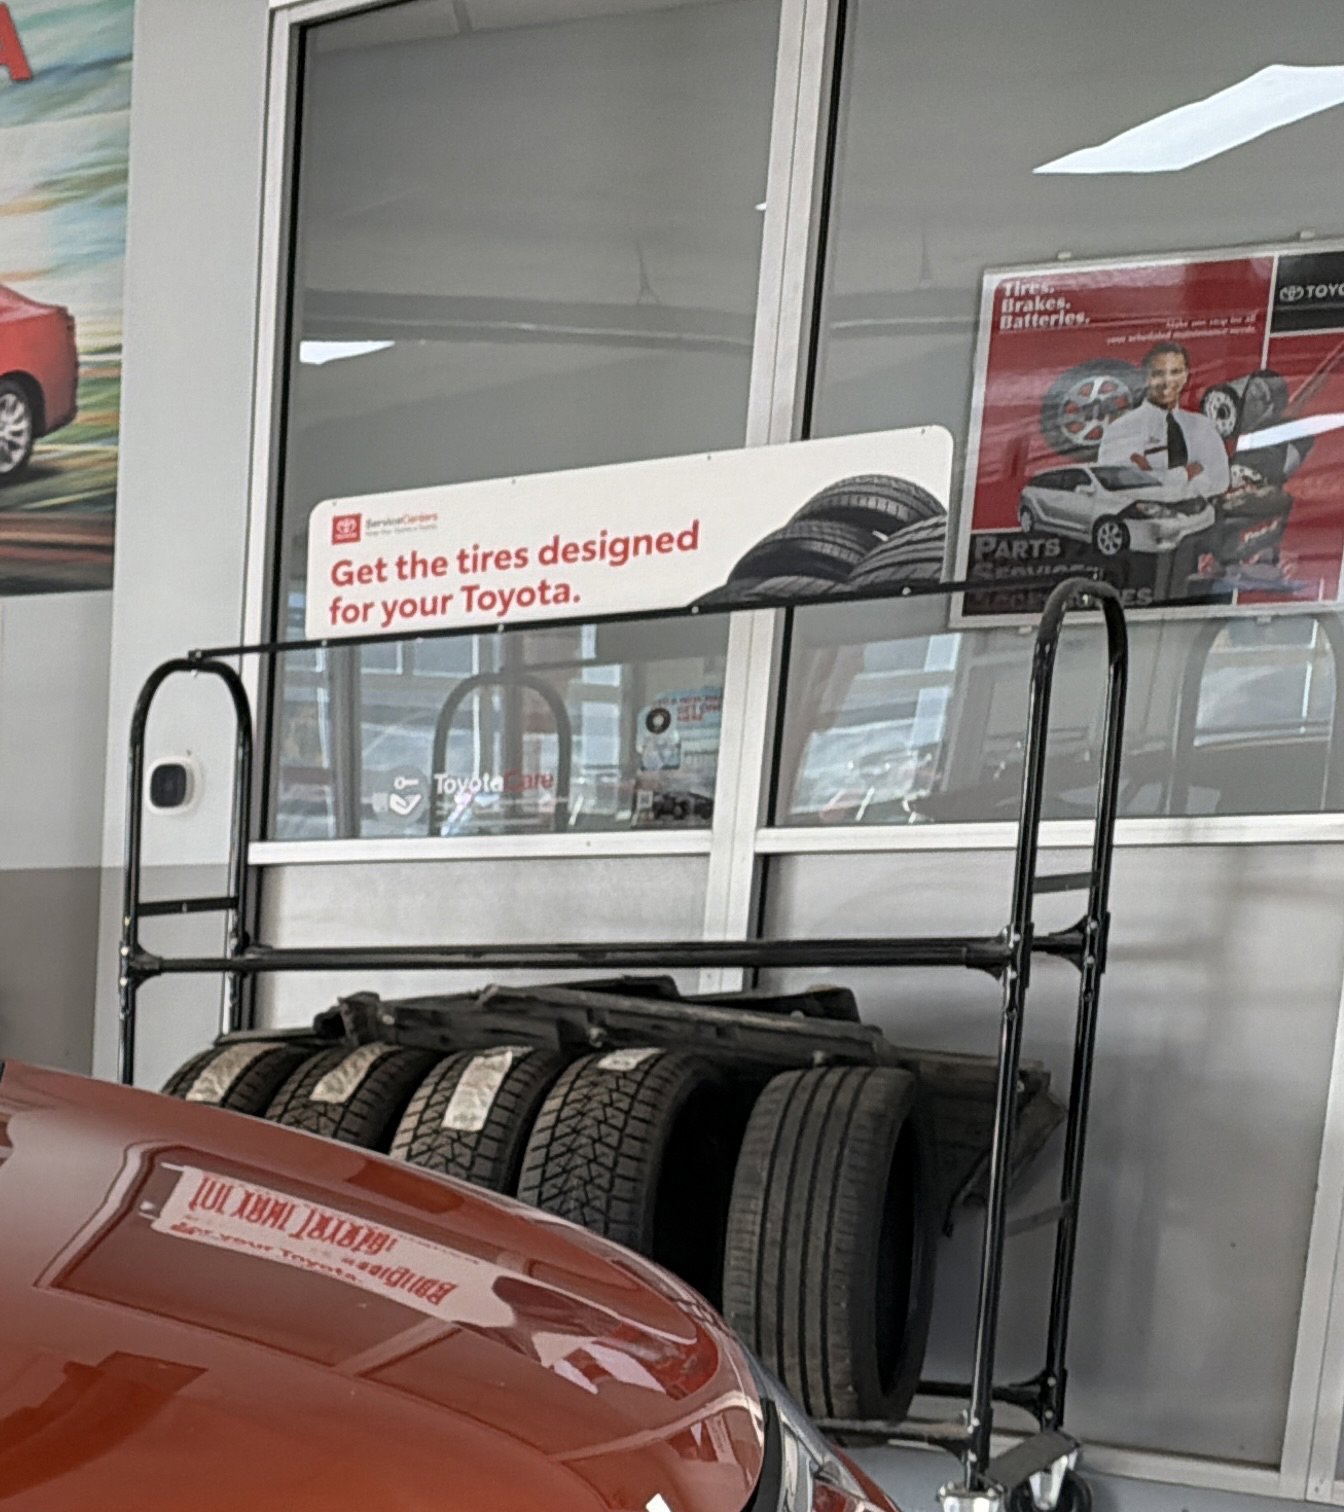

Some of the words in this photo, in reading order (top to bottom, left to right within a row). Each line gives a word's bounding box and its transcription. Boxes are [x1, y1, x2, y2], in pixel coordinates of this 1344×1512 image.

[1001, 280, 1055, 297] Tires.
[1001, 296, 1072, 313] Brakes.
[999, 309, 1091, 330] Batteries.
[330, 557, 389, 587] Get
[397, 550, 449, 581] the
[456, 543, 530, 575] tires
[538, 519, 701, 567] designed
[975, 536, 1061, 560] PARTS
[329, 594, 376, 626] for
[380, 589, 455, 629] your
[461, 579, 581, 618] Toyota.
[433, 768, 554, 795] ToyotaCare
